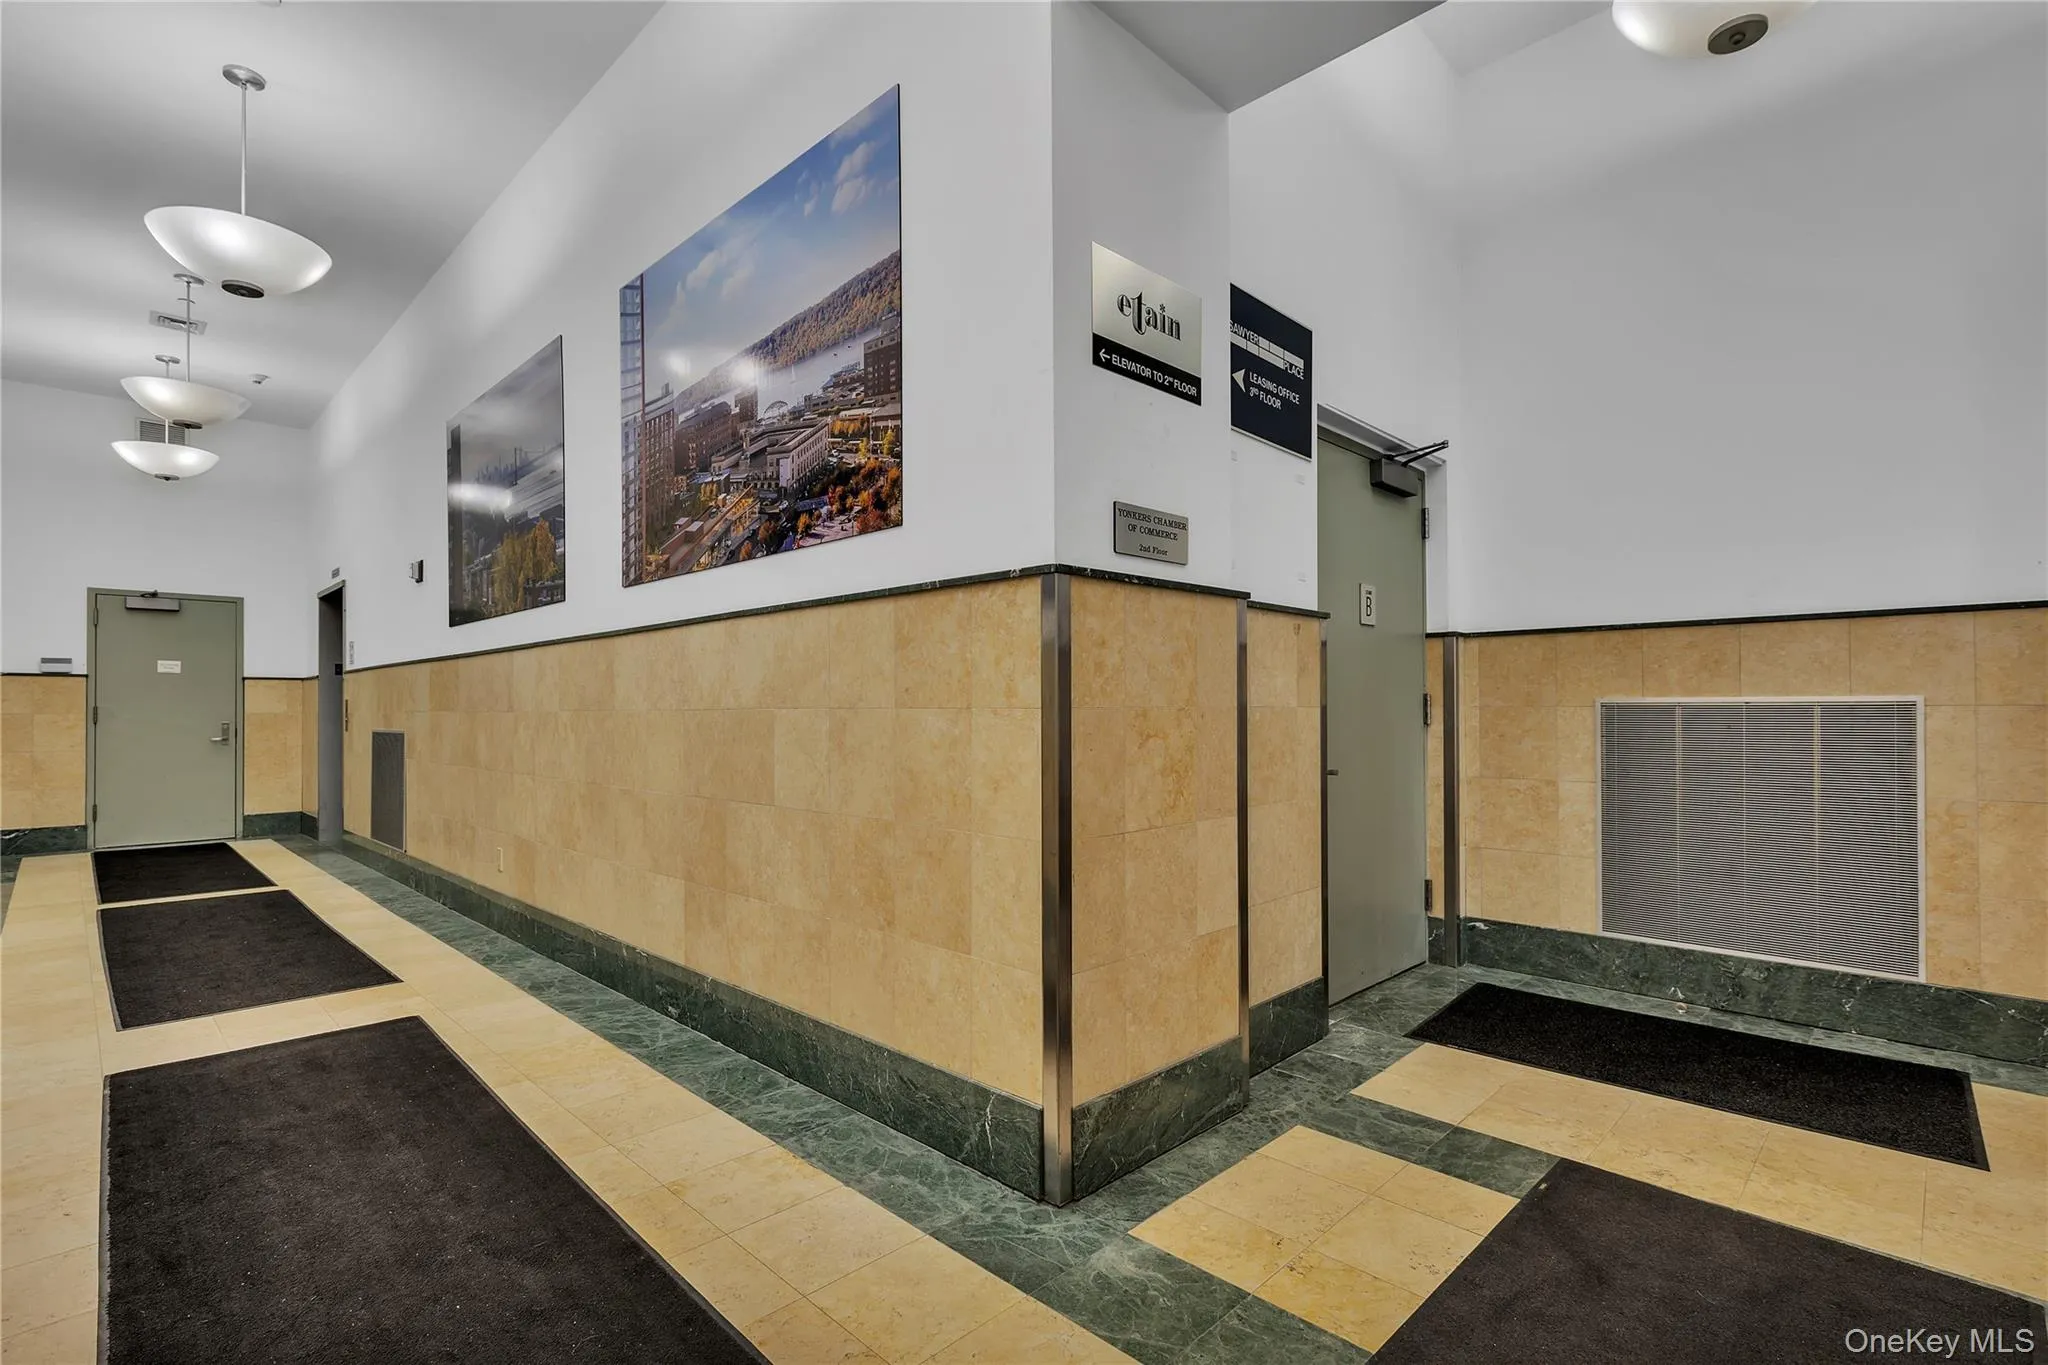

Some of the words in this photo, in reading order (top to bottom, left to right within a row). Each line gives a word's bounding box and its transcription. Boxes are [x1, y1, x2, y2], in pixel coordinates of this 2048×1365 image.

[1117, 291, 1182, 341] etain
[1229, 320, 1259, 345] SAWYER
[1112, 354, 1152, 379] ELEVATOR
[1153, 370, 1163, 383] TO
[1174, 379, 1197, 397] FLOOR
[1283, 361, 1304, 380] PLACE
[1250, 372, 1277, 393] LEASING
[1278, 385, 1300, 405] OFFICE
[1260, 391, 1282, 410] FLOOR
[1118, 508, 1152, 523] YONKERS
[1153, 516, 1187, 531] CHAMBER
[1128, 523, 1138, 532] OF
[1139, 526, 1178, 541] COMMERCE
[1139, 544, 1151, 552] 2nd
[1366, 596, 1372, 616] B
